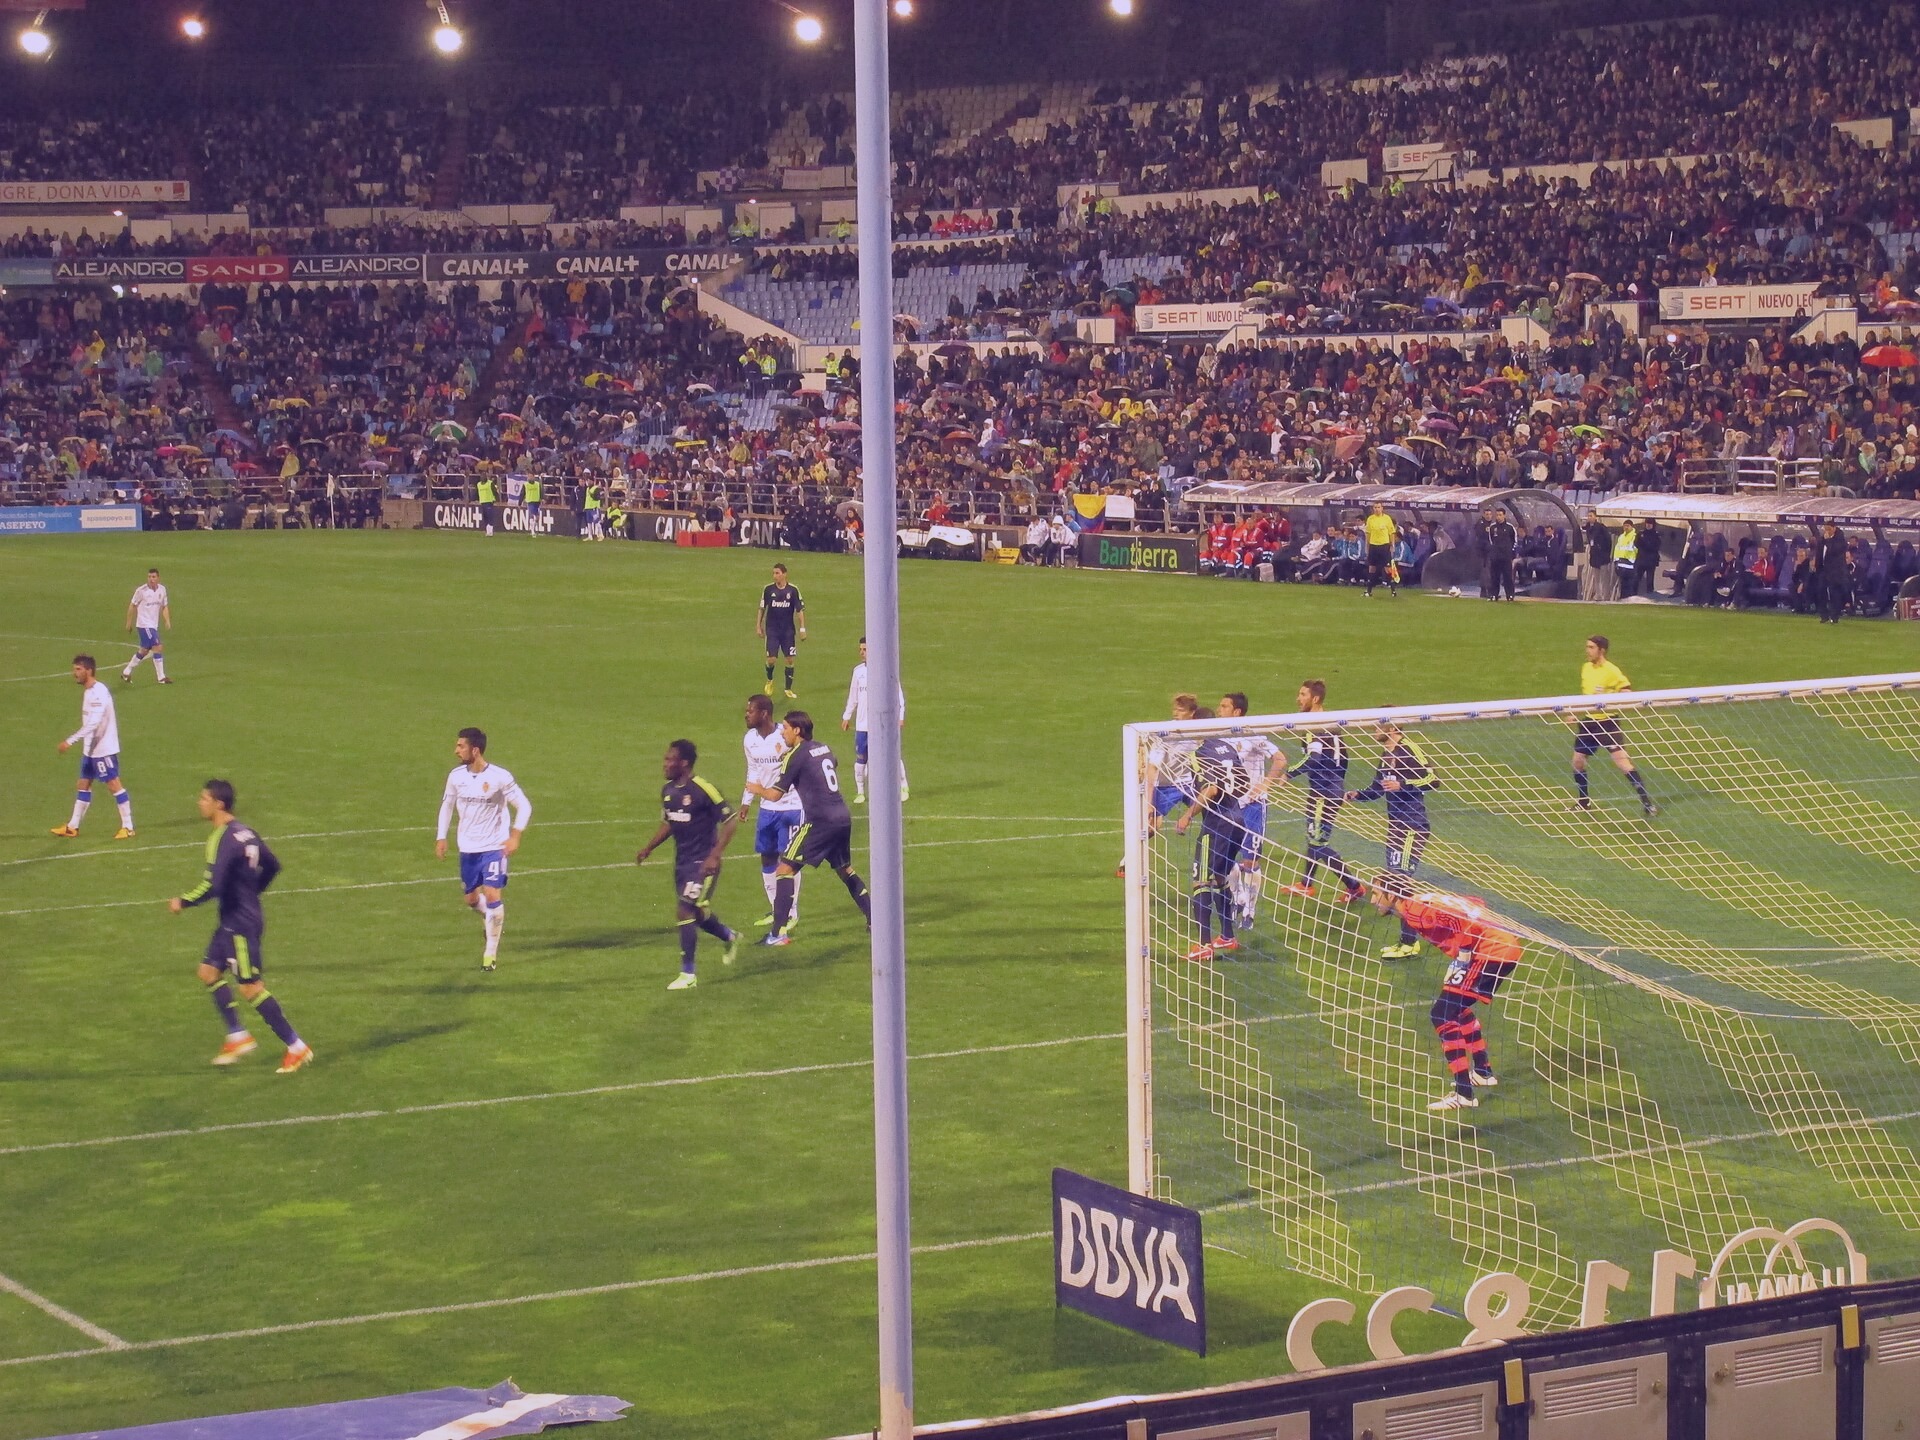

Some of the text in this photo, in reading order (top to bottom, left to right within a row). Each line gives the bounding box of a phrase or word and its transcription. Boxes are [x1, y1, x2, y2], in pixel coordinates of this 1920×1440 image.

[47, 185, 96, 200] DONA
[101, 184, 142, 199] VIDA
[56, 261, 184, 277] ALEJANDRO
[192, 263, 284, 277] SAND
[292, 257, 420, 273] ALEJANDRO
[443, 258, 529, 276] CANAL+
[556, 255, 639, 274] CANAL+
[1690, 295, 1746, 310] SEAT
[1758, 294, 1793, 309] NUEVO
[1158, 311, 1198, 324] SEAT
[1206, 311, 1232, 323] NUEVO
[434, 504, 482, 529] CANAL+
[503, 507, 554, 533] CANL+
[0, 521, 46, 530] ASEPEYO
[1100, 540, 1178, 569] Bantierra
[771, 600, 790, 608] bwin
[97, 761, 106, 773] 8
[822, 758, 839, 792] 6
[683, 881, 703, 899] 15
[1060, 1197, 1197, 1323] BBVA
